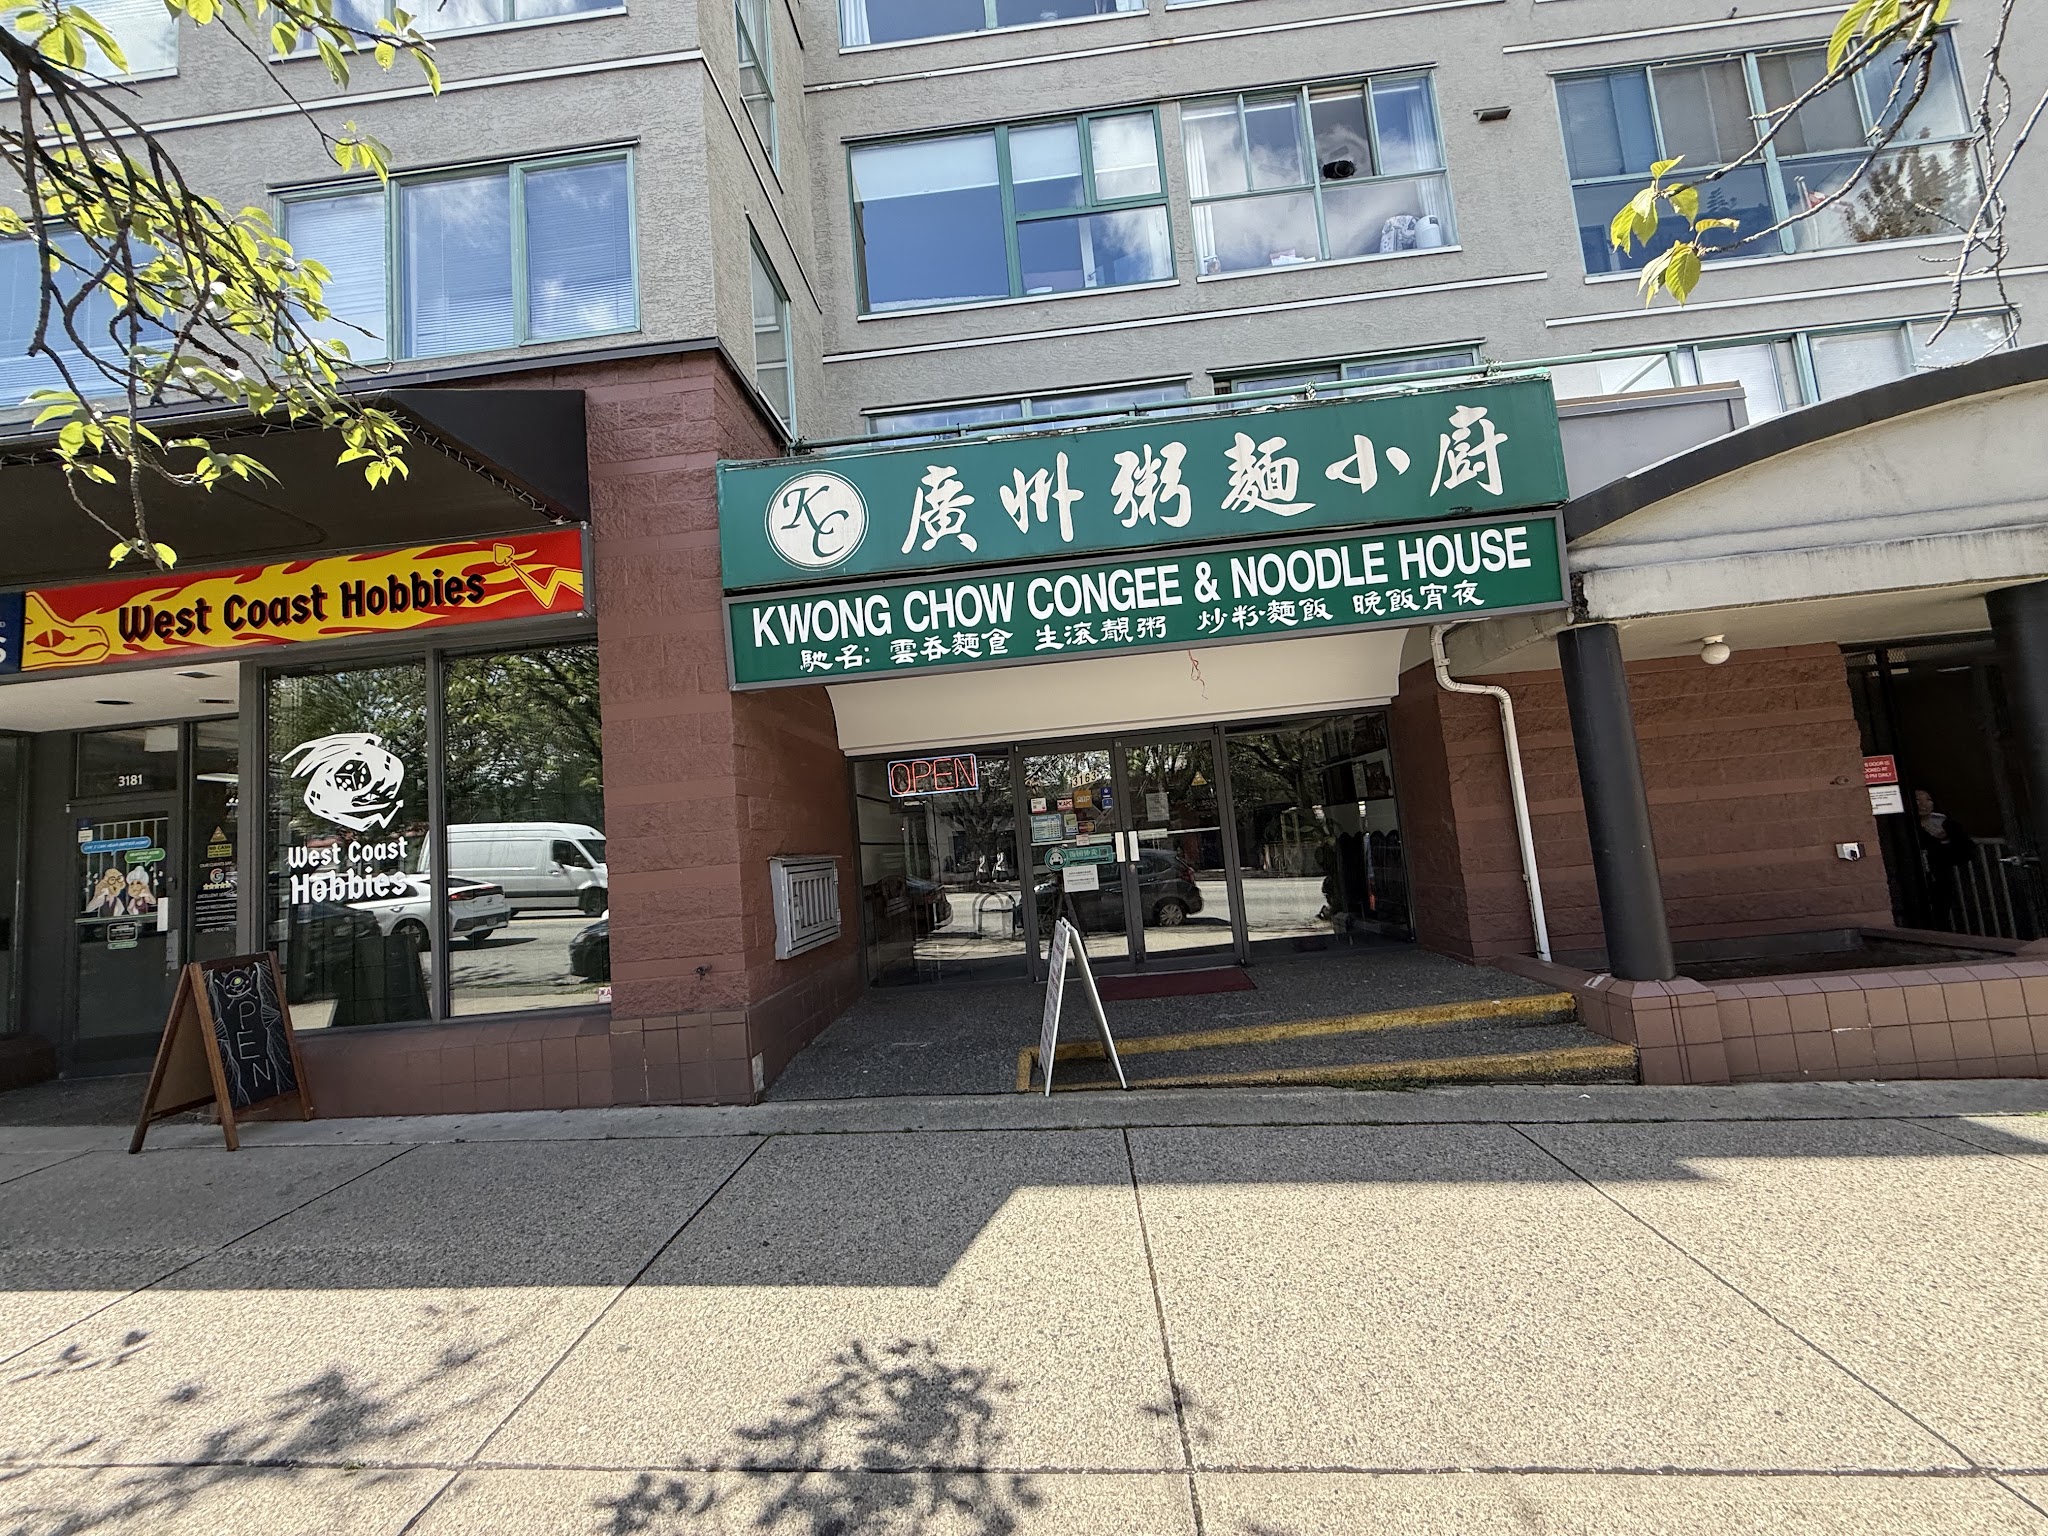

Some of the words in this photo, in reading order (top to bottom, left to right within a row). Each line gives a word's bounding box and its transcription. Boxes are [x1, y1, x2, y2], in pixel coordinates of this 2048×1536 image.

[752, 595, 892, 647] KWONG
[903, 581, 1014, 632] CHOW
[1026, 564, 1183, 620] CONGEE
[1194, 561, 1221, 603] &
[1231, 542, 1388, 599] NOODLE
[1399, 526, 1532, 581] HOUSE
[118, 597, 213, 644] West
[223, 583, 328, 631] Coast
[339, 568, 487, 619] Hobbies
[118, 774, 142, 787] 3181
[891, 755, 976, 795] OPEN
[1072, 771, 1097, 786] 3163
[288, 842, 341, 868] West
[348, 836, 408, 863] Coast
[290, 866, 408, 904] Hobbies
